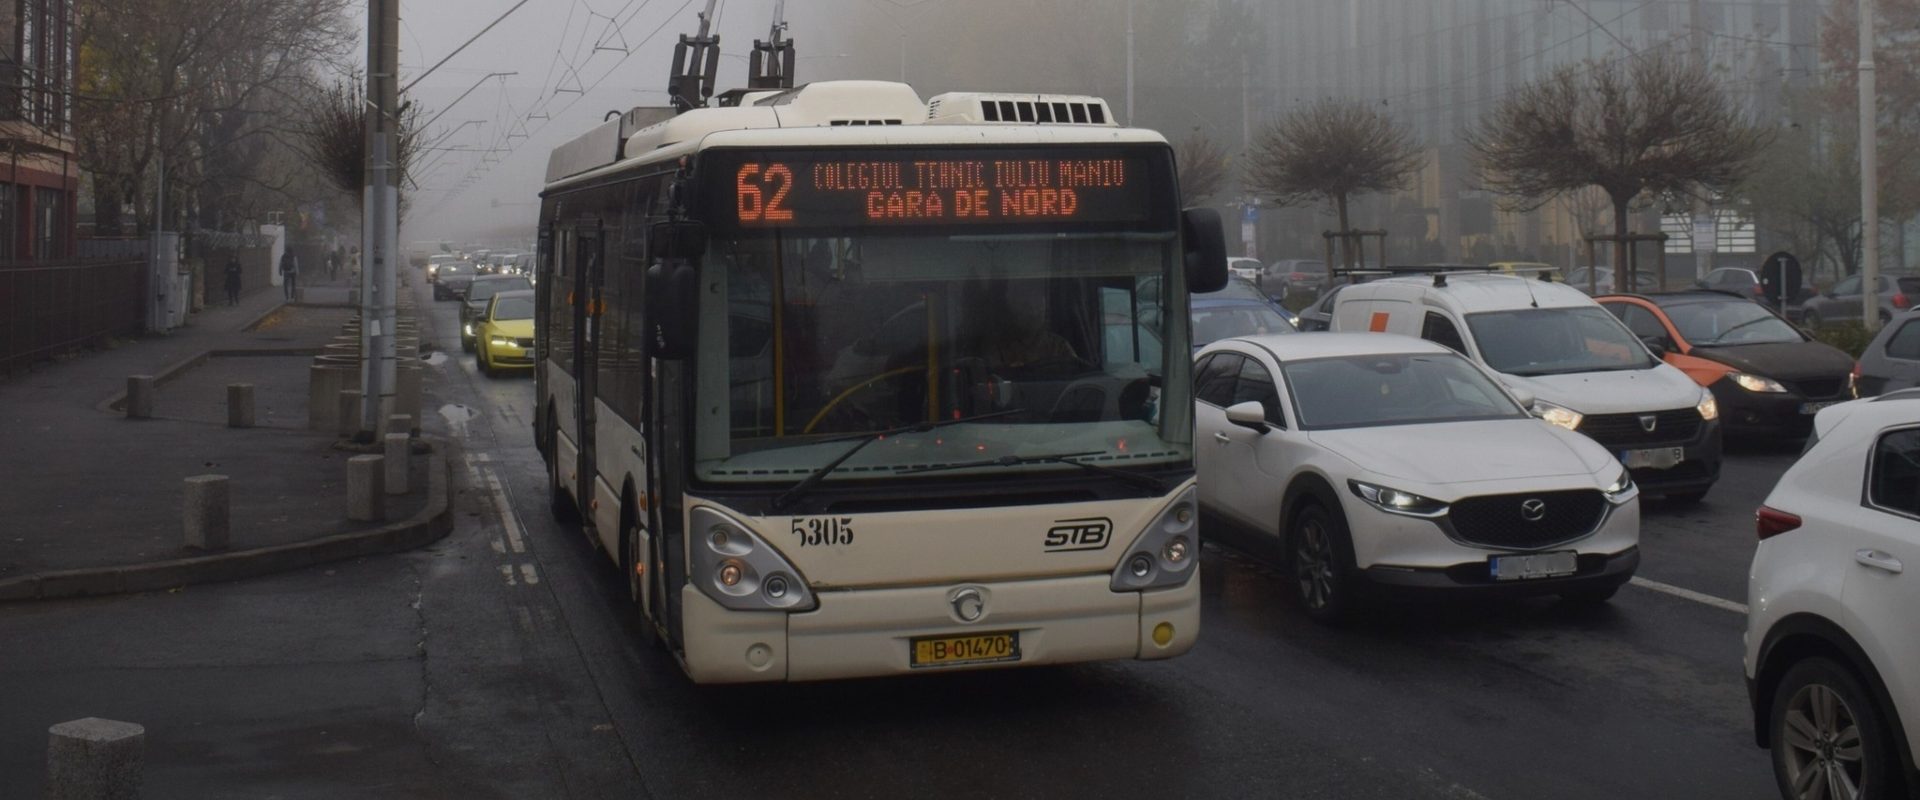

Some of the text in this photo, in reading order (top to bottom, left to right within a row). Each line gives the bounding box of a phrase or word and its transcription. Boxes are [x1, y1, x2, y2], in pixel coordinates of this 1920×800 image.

[814, 159, 1124, 190] COLEGIUL TEHNIC IULIU MANIU
[737, 163, 793, 221] 62
[867, 189, 1078, 218] GARA DE NORD
[791, 518, 854, 547] 5305
[1044, 524, 1106, 547] STB
[934, 637, 1007, 659] B 01470
